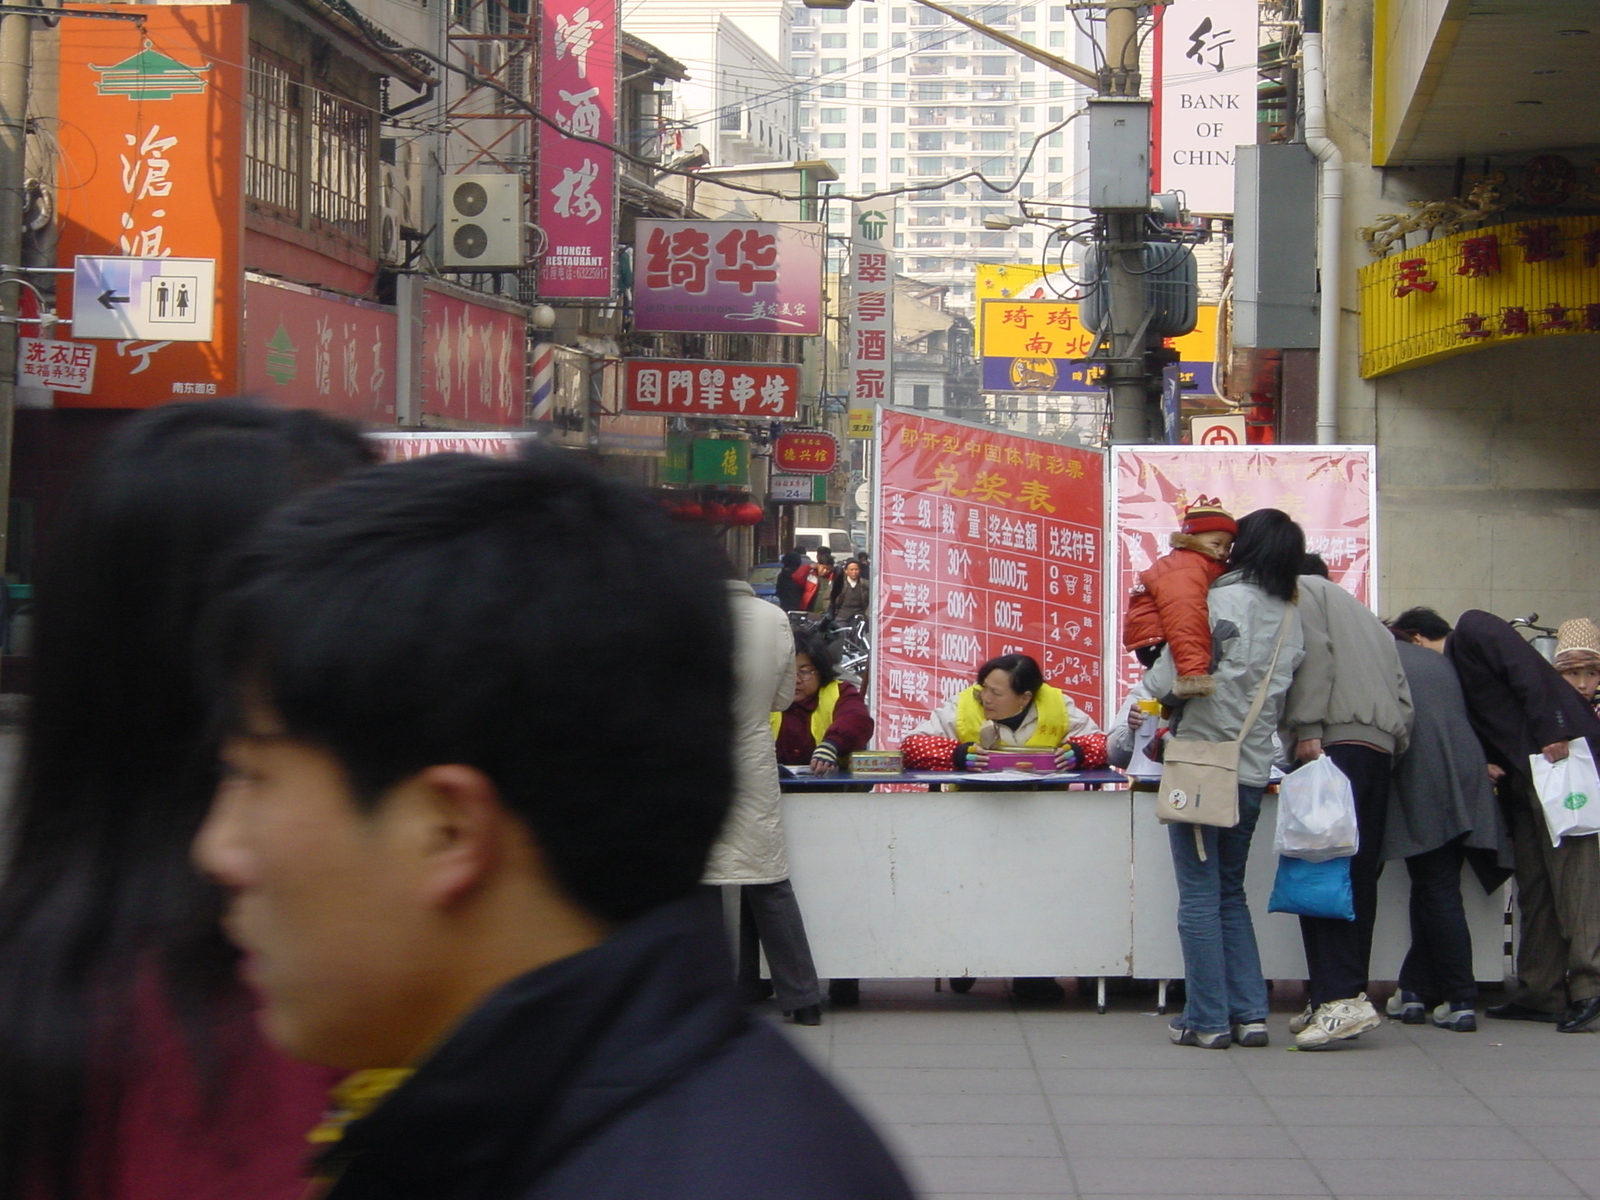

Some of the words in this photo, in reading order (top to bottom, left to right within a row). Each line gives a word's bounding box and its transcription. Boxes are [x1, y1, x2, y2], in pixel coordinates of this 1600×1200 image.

[1186, 17, 1235, 72] 行
[1181, 94, 1240, 109] BANK
[1196, 123, 1224, 137] OF
[546, 256, 604, 266] RESTAURANT
[556, 246, 592, 255] HONGZE
[646, 227, 778, 294] 绮华
[856, 253, 887, 398] 翠亨酒家
[26, 342, 92, 367] 洗衣店
[901, 427, 1085, 480] 即开型中国体育彩票
[927, 462, 1056, 513] 兑奖表
[892, 494, 931, 529] 奖级
[942, 503, 981, 539] 数量
[989, 514, 1038, 553] 奖金金额
[1049, 526, 1096, 564] 兑奖符号
[891, 539, 931, 572] 一等奖
[947, 548, 972, 580] 30个
[890, 583, 930, 615] 二等奖
[947, 590, 978, 623] 600个
[994, 600, 1024, 633] 600元
[889, 626, 931, 660] 三等奖
[940, 635, 982, 668] 10500个
[888, 669, 930, 703] 四等奖
[887, 713, 926, 743] 五等
